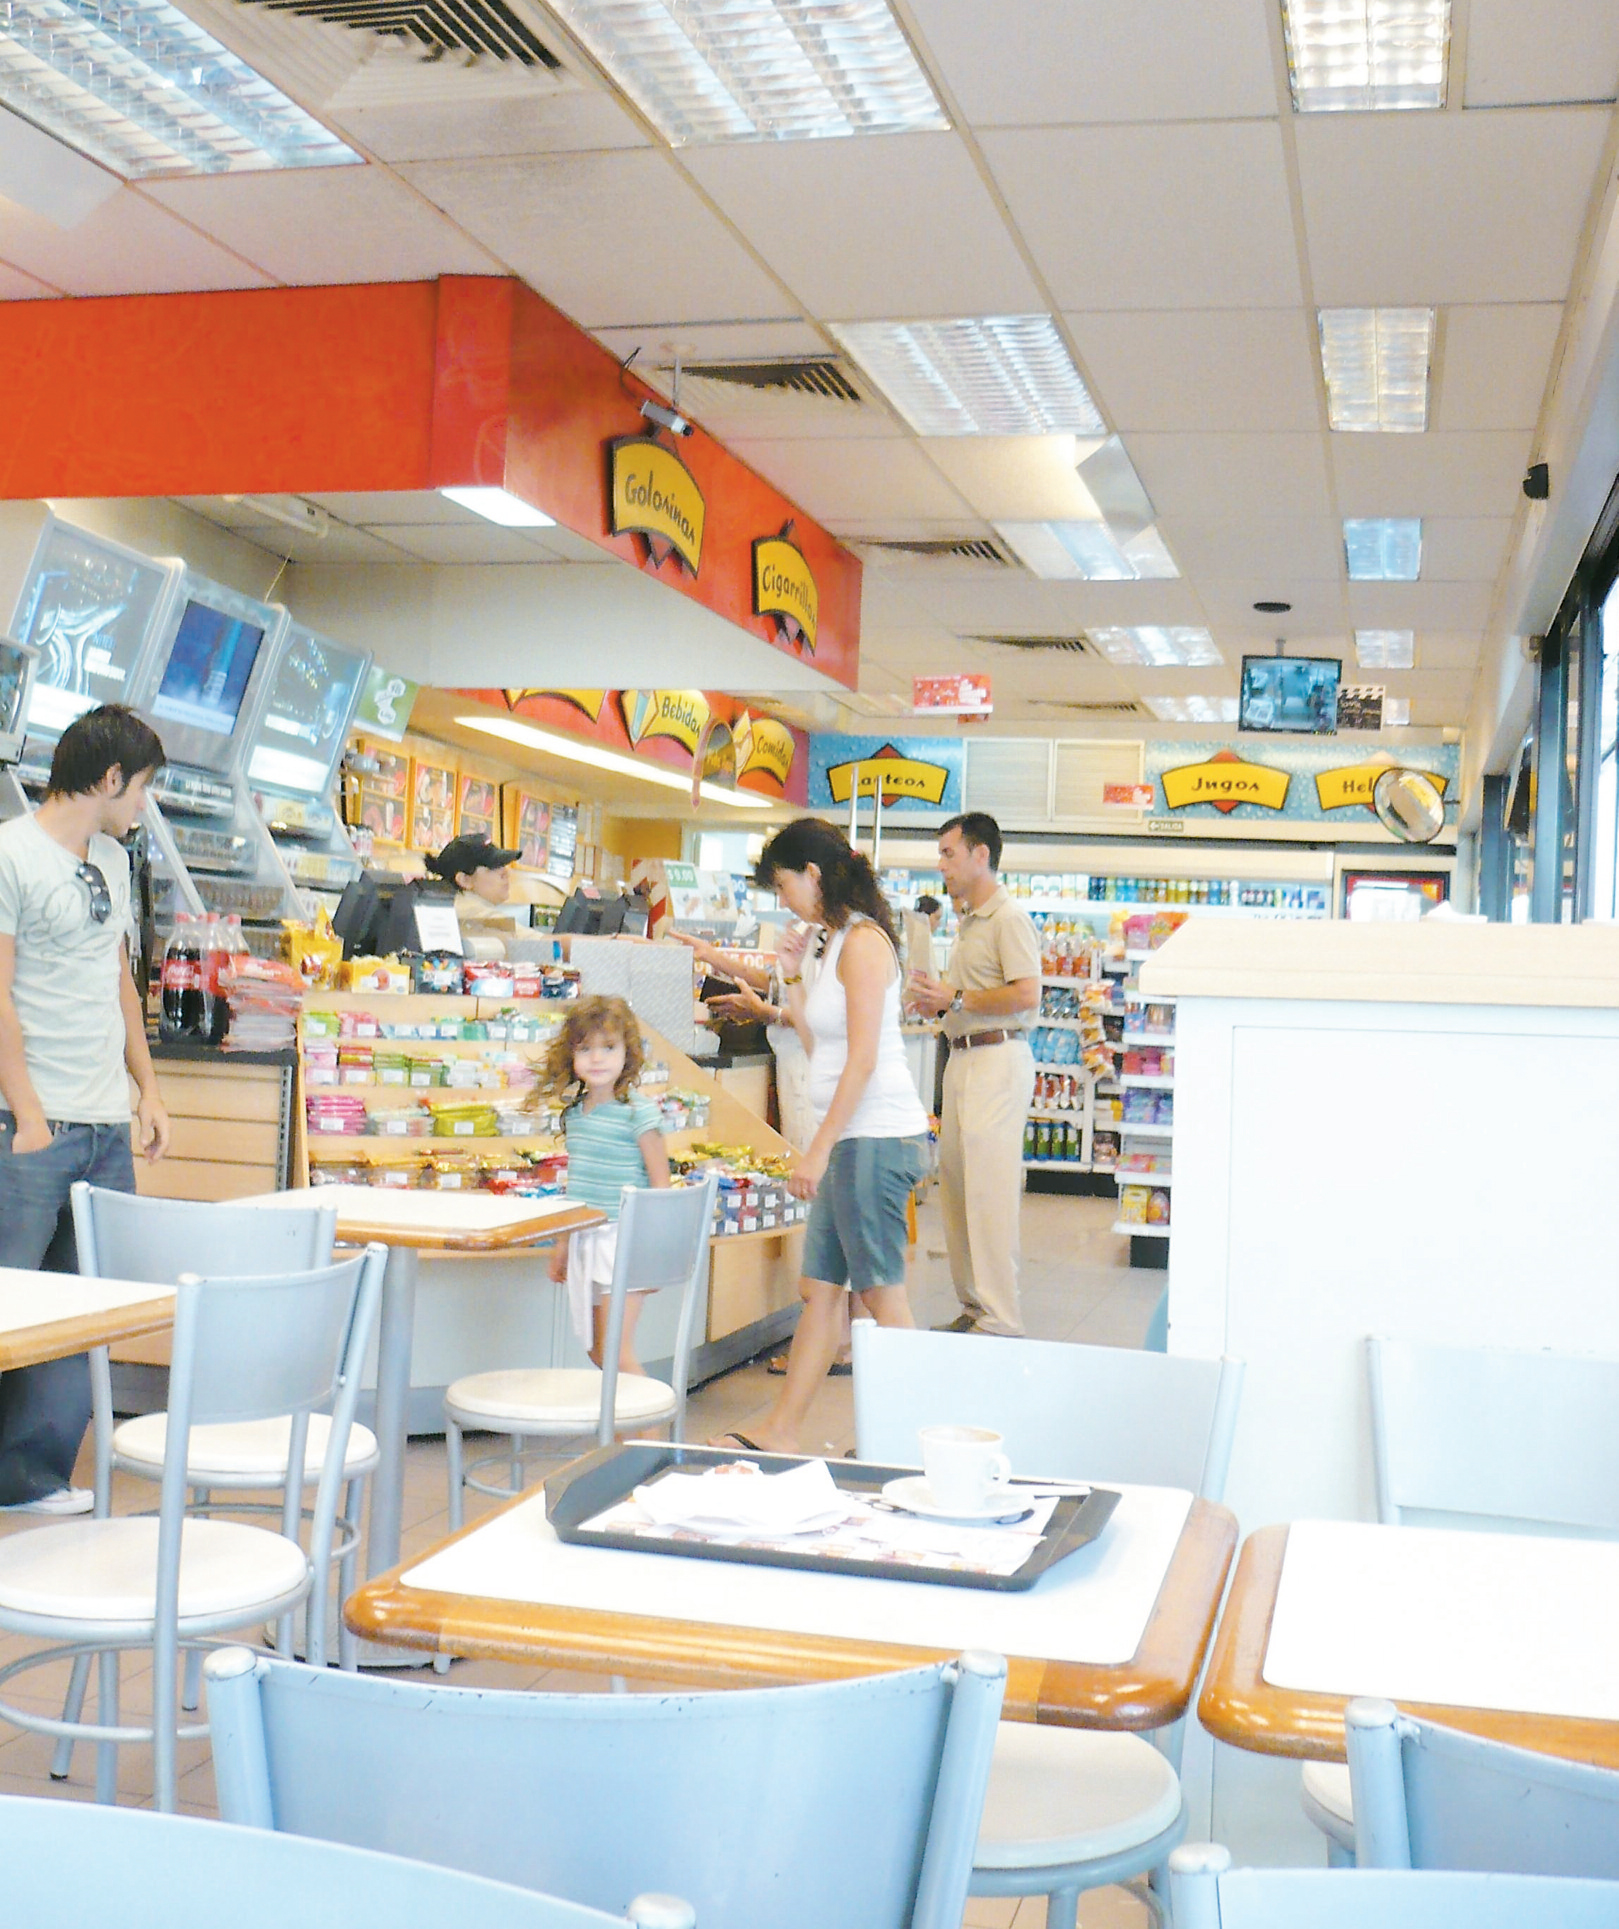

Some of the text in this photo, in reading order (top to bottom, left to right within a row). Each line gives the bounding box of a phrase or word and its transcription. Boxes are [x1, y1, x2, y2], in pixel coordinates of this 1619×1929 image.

[624, 471, 695, 546] Golosinas
[762, 565, 816, 629] Cigarrillos
[661, 695, 701, 737] Bebidas
[855, 773, 926, 788] ateos
[1191, 777, 1260, 793] Jugos
[1342, 777, 1374, 793] Hel
